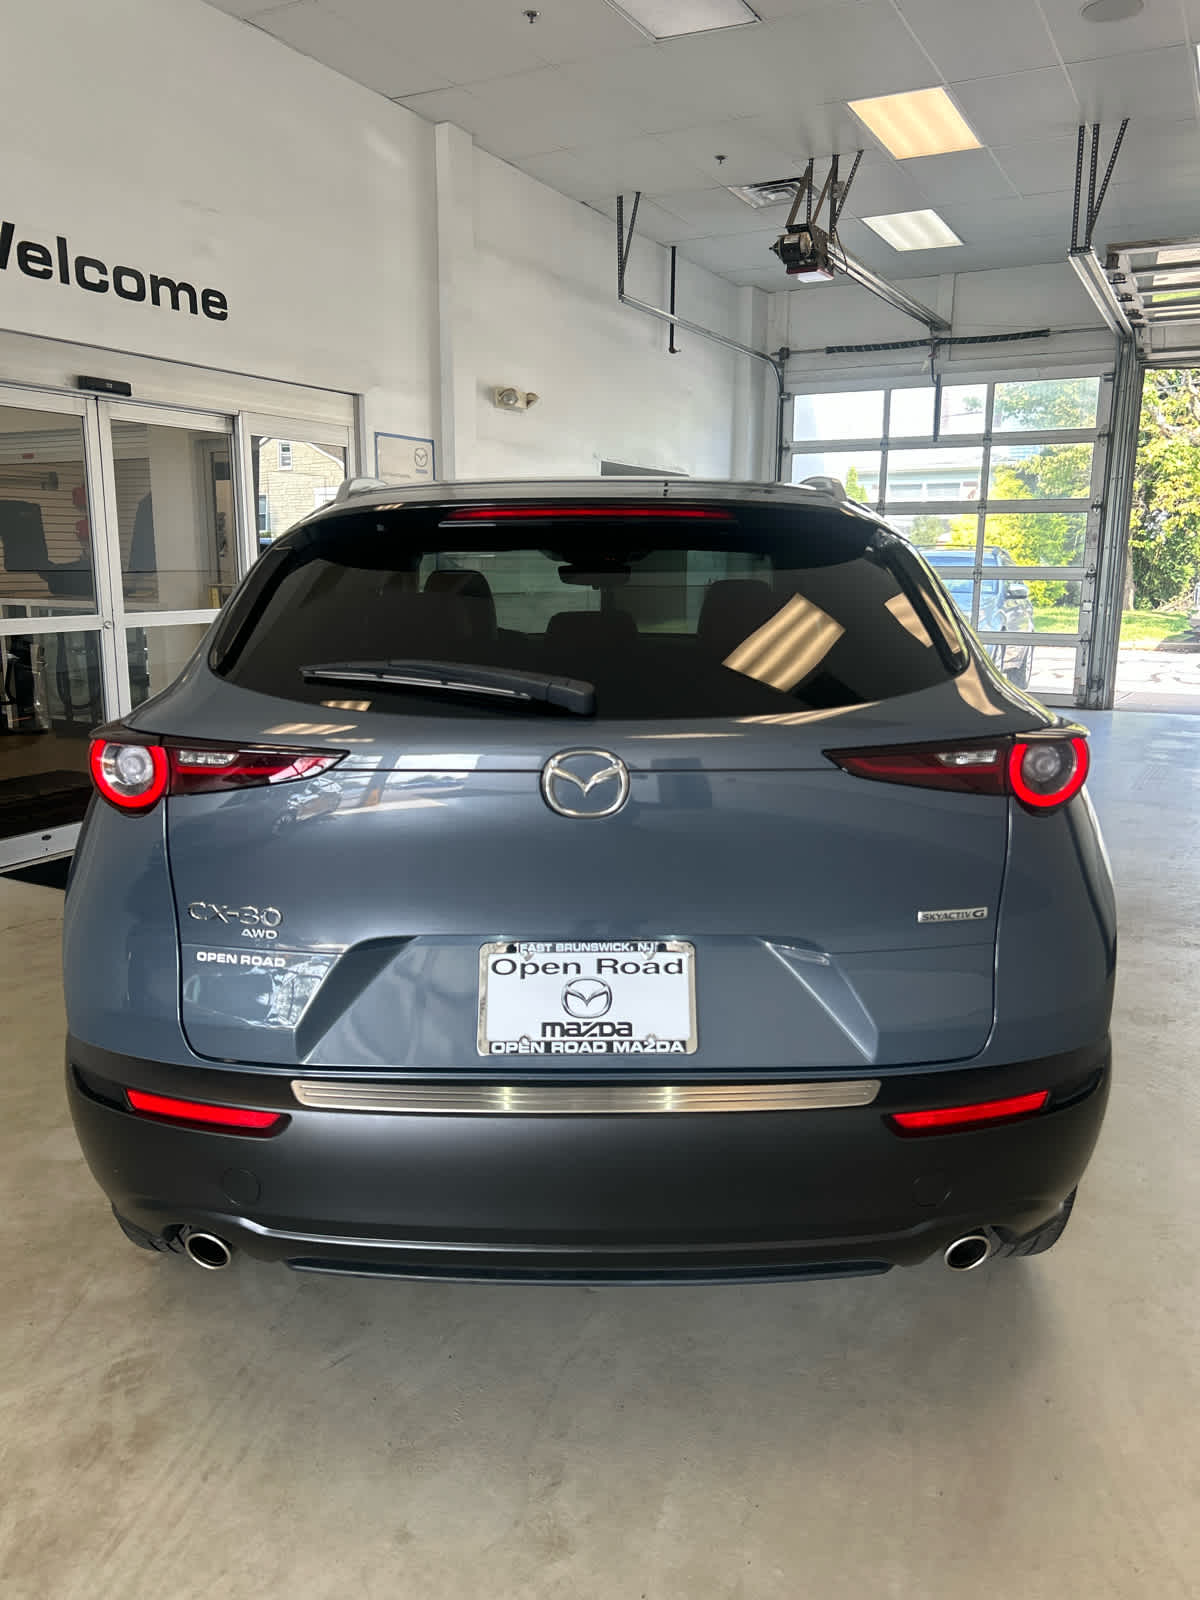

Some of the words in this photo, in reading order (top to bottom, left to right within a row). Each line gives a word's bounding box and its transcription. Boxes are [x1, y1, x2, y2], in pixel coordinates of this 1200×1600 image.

[188, 901, 282, 927] CX-30
[240, 928, 278, 940] AWD
[520, 942, 552, 953] EAST
[555, 942, 634, 952] BRUNSWICK,
[637, 942, 655, 952] NJ
[196, 951, 238, 964] OPEN
[240, 954, 286, 967] ROAD
[491, 958, 581, 980] Open
[596, 958, 684, 975] Road
[490, 1040, 546, 1054] OPEN
[550, 1041, 607, 1054] ROAD
[612, 1041, 685, 1053] MAZDA
